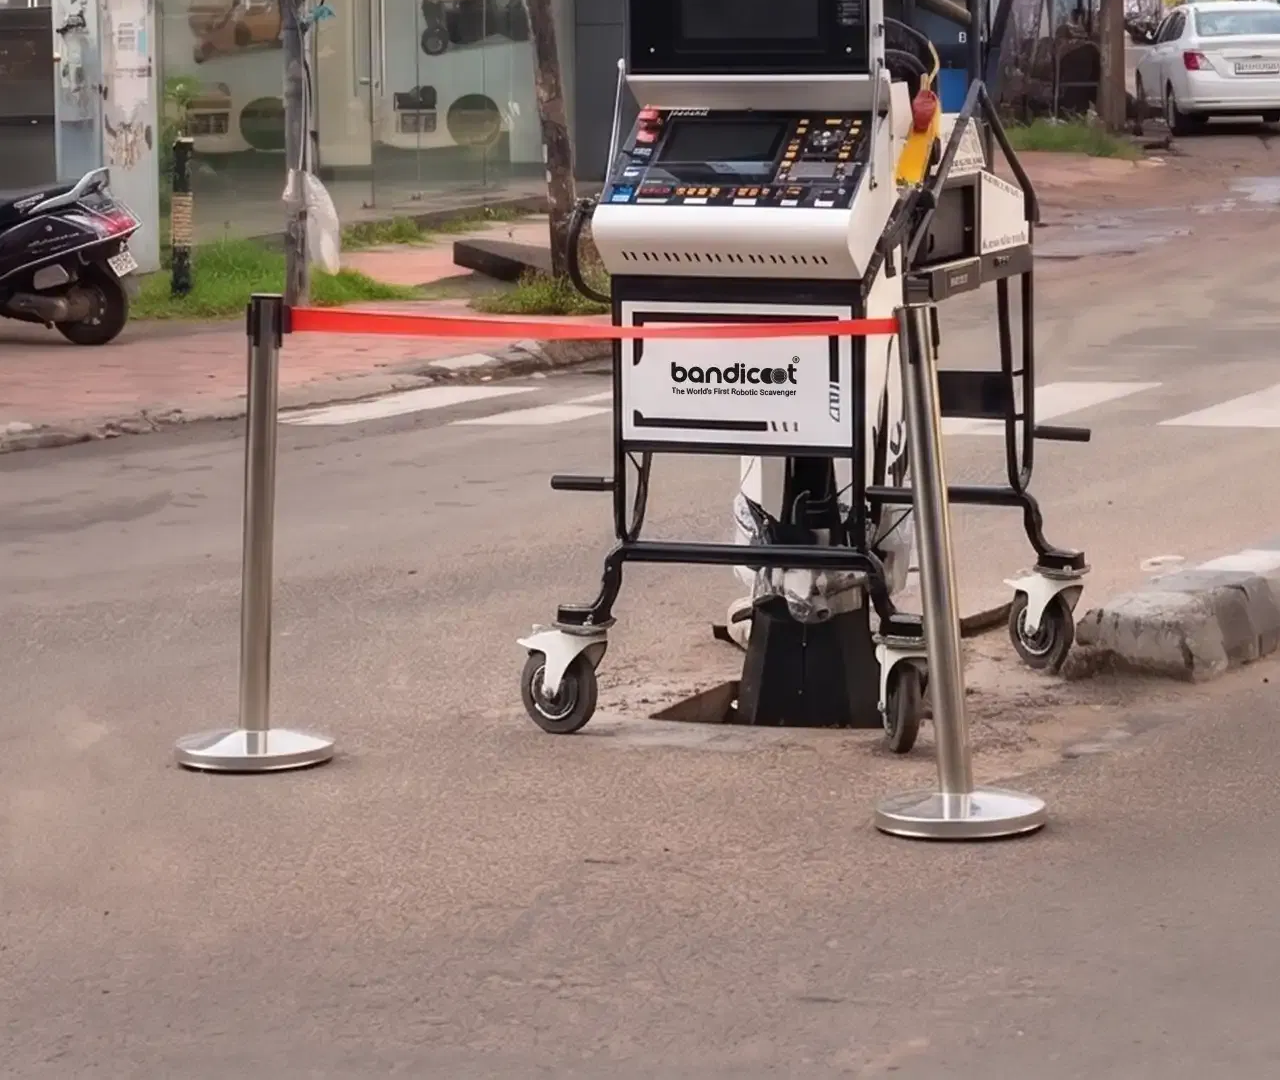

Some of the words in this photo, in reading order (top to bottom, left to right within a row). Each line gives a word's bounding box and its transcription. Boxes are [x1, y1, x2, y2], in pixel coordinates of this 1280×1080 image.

[672, 386, 685, 395] The
[686, 387, 712, 395] World's
[713, 387, 730, 395] First
[731, 387, 758, 396] Robotic
[759, 388, 797, 398] Scavenger
